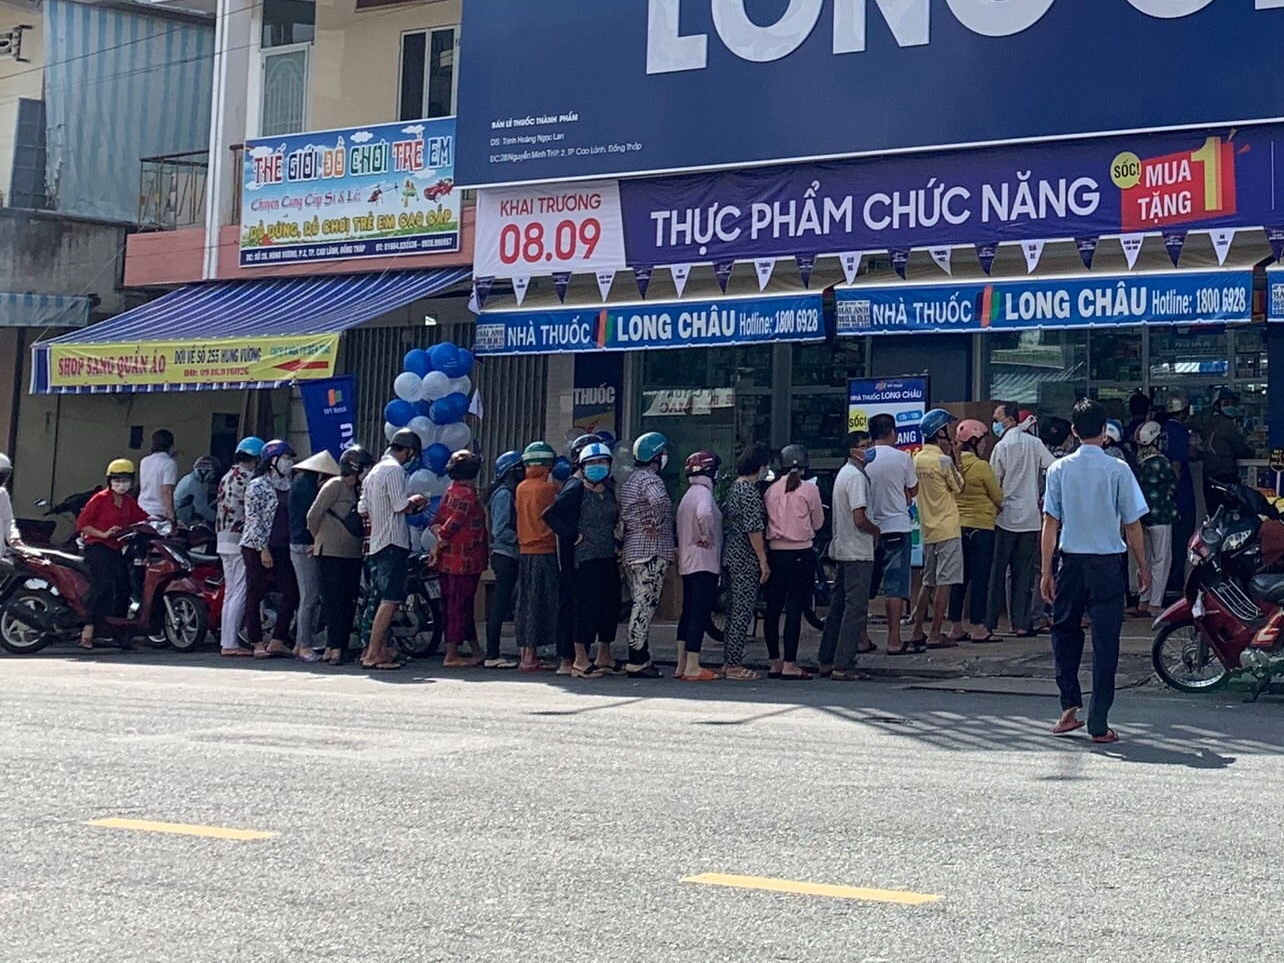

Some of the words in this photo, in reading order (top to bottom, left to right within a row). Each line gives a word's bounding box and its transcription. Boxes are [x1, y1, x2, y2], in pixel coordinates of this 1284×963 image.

[513, 114, 535, 127] THUỐC
[536, 113, 558, 125] THÀNH
[559, 110, 579, 122] PHẨM
[537, 133, 552, 143] Ngọc
[552, 132, 565, 141] Lan
[575, 146, 590, 156] Cao
[608, 141, 626, 153] Đồng
[626, 141, 643, 153] Tháp
[254, 143, 286, 184] THẾ
[288, 144, 318, 180] GIỚI
[322, 135, 345, 177] ĐỒ
[351, 138, 388, 175] CHƠI
[393, 130, 424, 172] TRẺ
[429, 136, 452, 168] EM
[1114, 159, 1140, 179] SỐC!
[1145, 159, 1192, 188] MUA
[1190, 136, 1222, 211] 1
[500, 198, 534, 216] KHAI
[537, 193, 602, 215] TRƯƠNG
[650, 200, 742, 255] THỰC
[750, 180, 853, 239] PHẨM
[862, 177, 971, 230] CHỨC
[981, 170, 1100, 223] NĂNG
[1137, 190, 1192, 224] TẶNG
[352, 210, 376, 233] TRẺ
[377, 213, 395, 230] EM
[399, 211, 424, 229] CAO
[425, 203, 453, 226] CẤP
[500, 218, 602, 265] 08.09
[851, 305, 869, 314] ANH
[872, 297, 908, 325] NHÀ
[912, 291, 972, 324] THUỐC
[1005, 290, 1071, 321] LONG
[1077, 280, 1148, 317] CHÂU
[1151, 288, 1193, 315] Hotline:
[1195, 287, 1220, 313] 1800
[1221, 286, 1247, 313] 6928
[507, 320, 537, 347] NHÀ
[540, 314, 591, 345] THUỐC
[617, 312, 674, 342] LONG
[677, 304, 737, 338] CHÂU
[739, 311, 773, 336] Hotline:
[774, 309, 796, 334] 1800
[796, 307, 819, 332] 6928
[58, 355, 85, 377] SHOP
[86, 355, 115, 376] SANG
[116, 345, 149, 378] QUẦN
[150, 347, 166, 375] ÁO
[207, 349, 220, 363] 255
[573, 382, 616, 406] THUỐC
[862, 392, 880, 400] THUỐC
[881, 390, 901, 400] LONG
[902, 388, 922, 399] CHÂU
[849, 414, 867, 428] SỐC!
